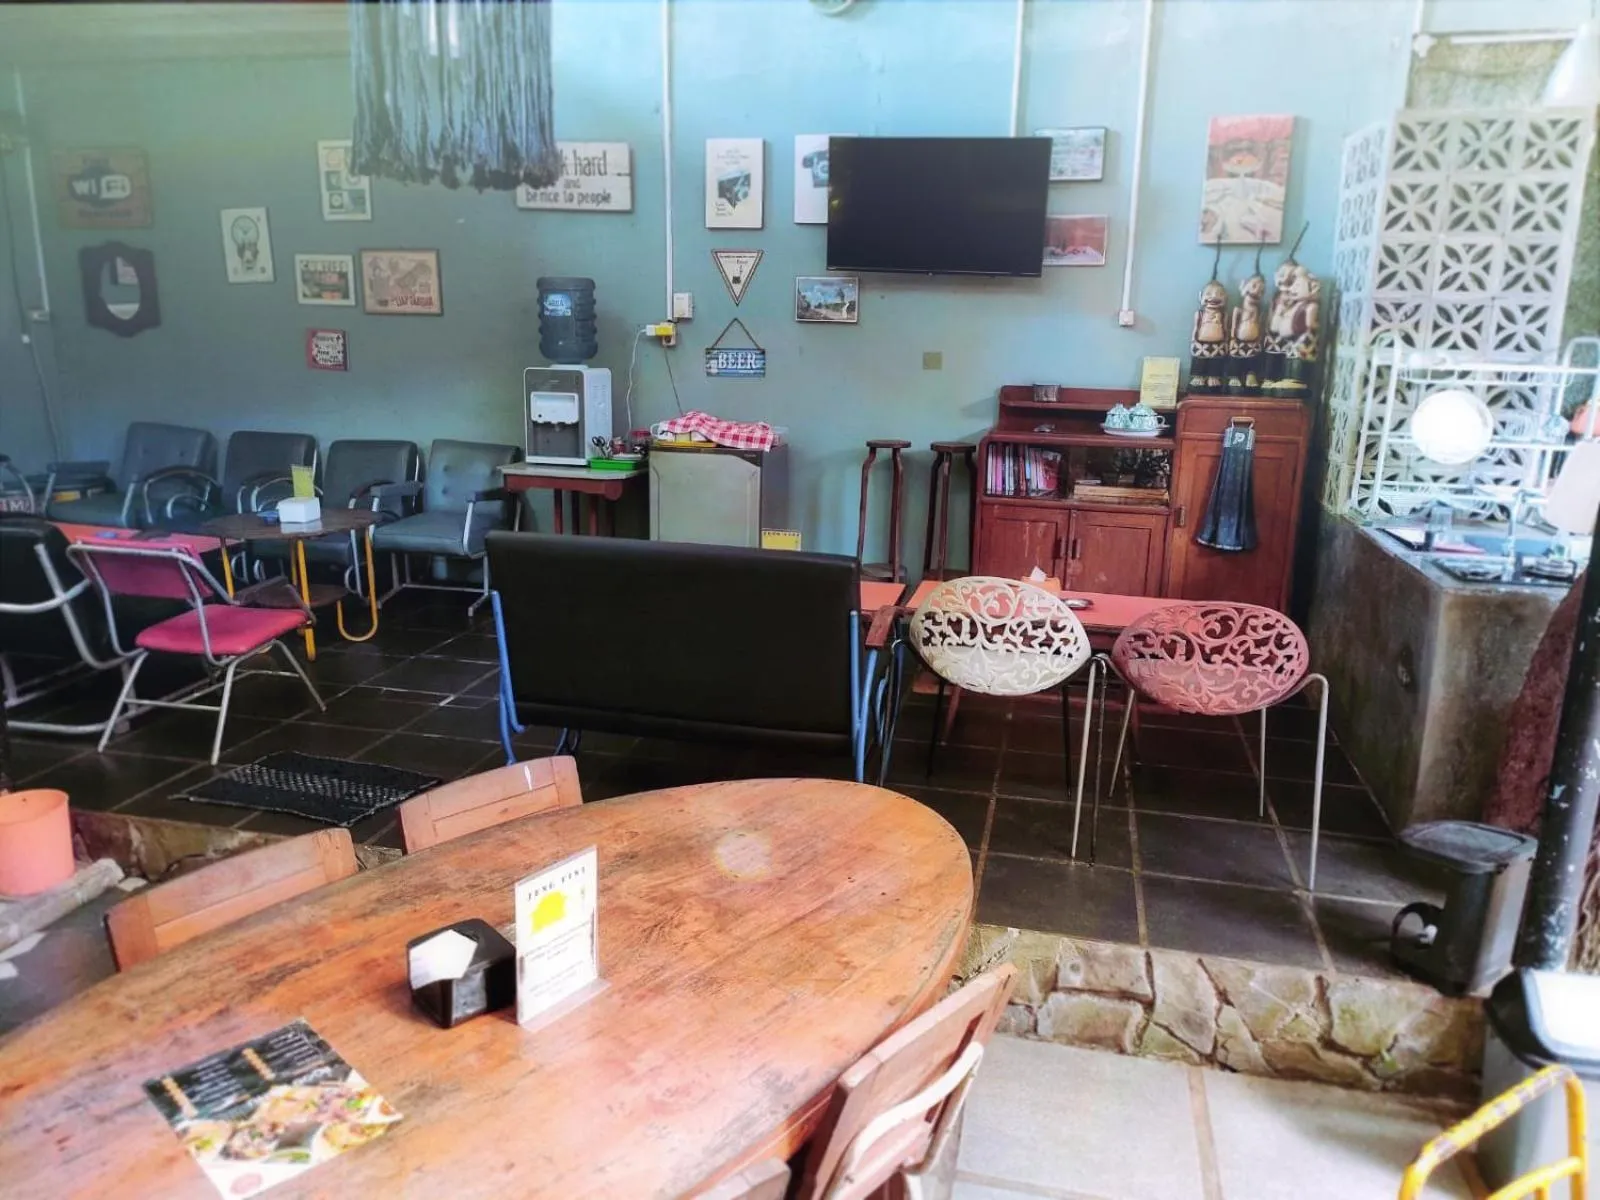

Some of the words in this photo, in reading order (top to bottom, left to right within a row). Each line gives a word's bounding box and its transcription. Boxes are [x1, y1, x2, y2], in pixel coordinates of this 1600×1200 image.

[573, 149, 608, 176] hard
[526, 190, 538, 202] be
[539, 191, 560, 203] nice
[563, 191, 575, 203] to
[577, 189, 611, 207] people
[717, 352, 757, 369] BEER
